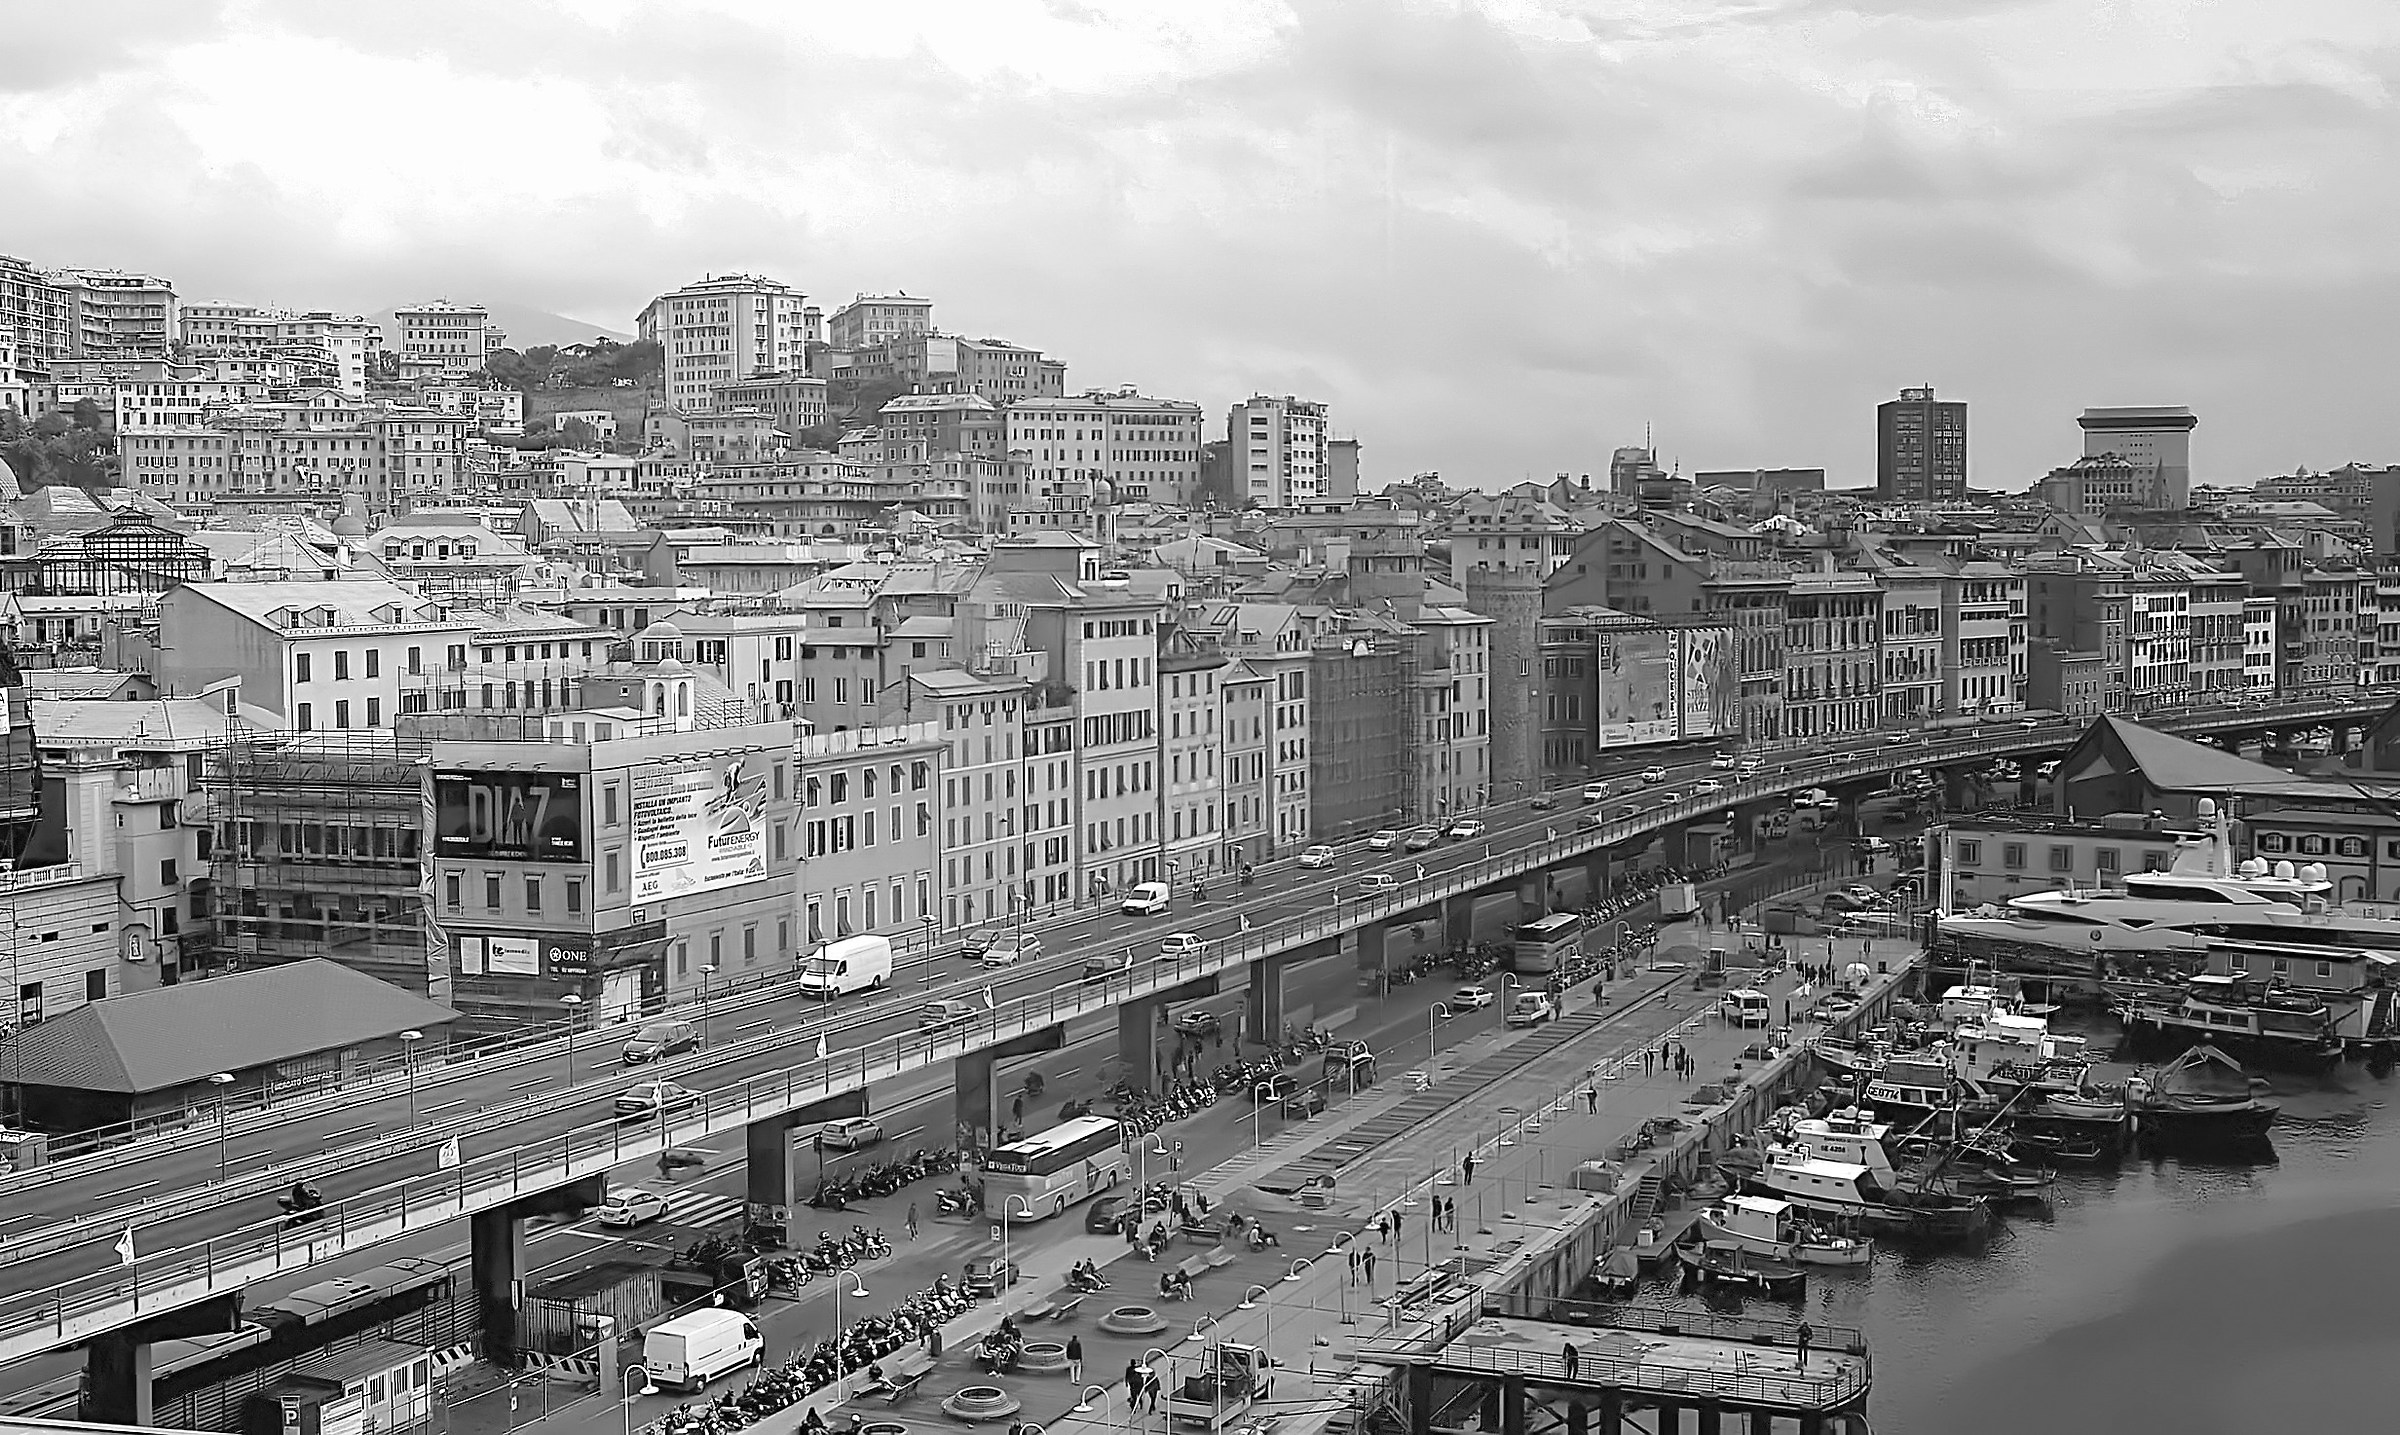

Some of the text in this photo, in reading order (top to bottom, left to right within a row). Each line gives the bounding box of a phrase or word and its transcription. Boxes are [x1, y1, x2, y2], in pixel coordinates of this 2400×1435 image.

[468, 785, 550, 844] DIAZ
[642, 880, 658, 892] AEG
[562, 950, 588, 961] ONE
[1175, 1141, 1182, 1151] P
[961, 1151, 970, 1162] P
[285, 1410, 298, 1424] P
